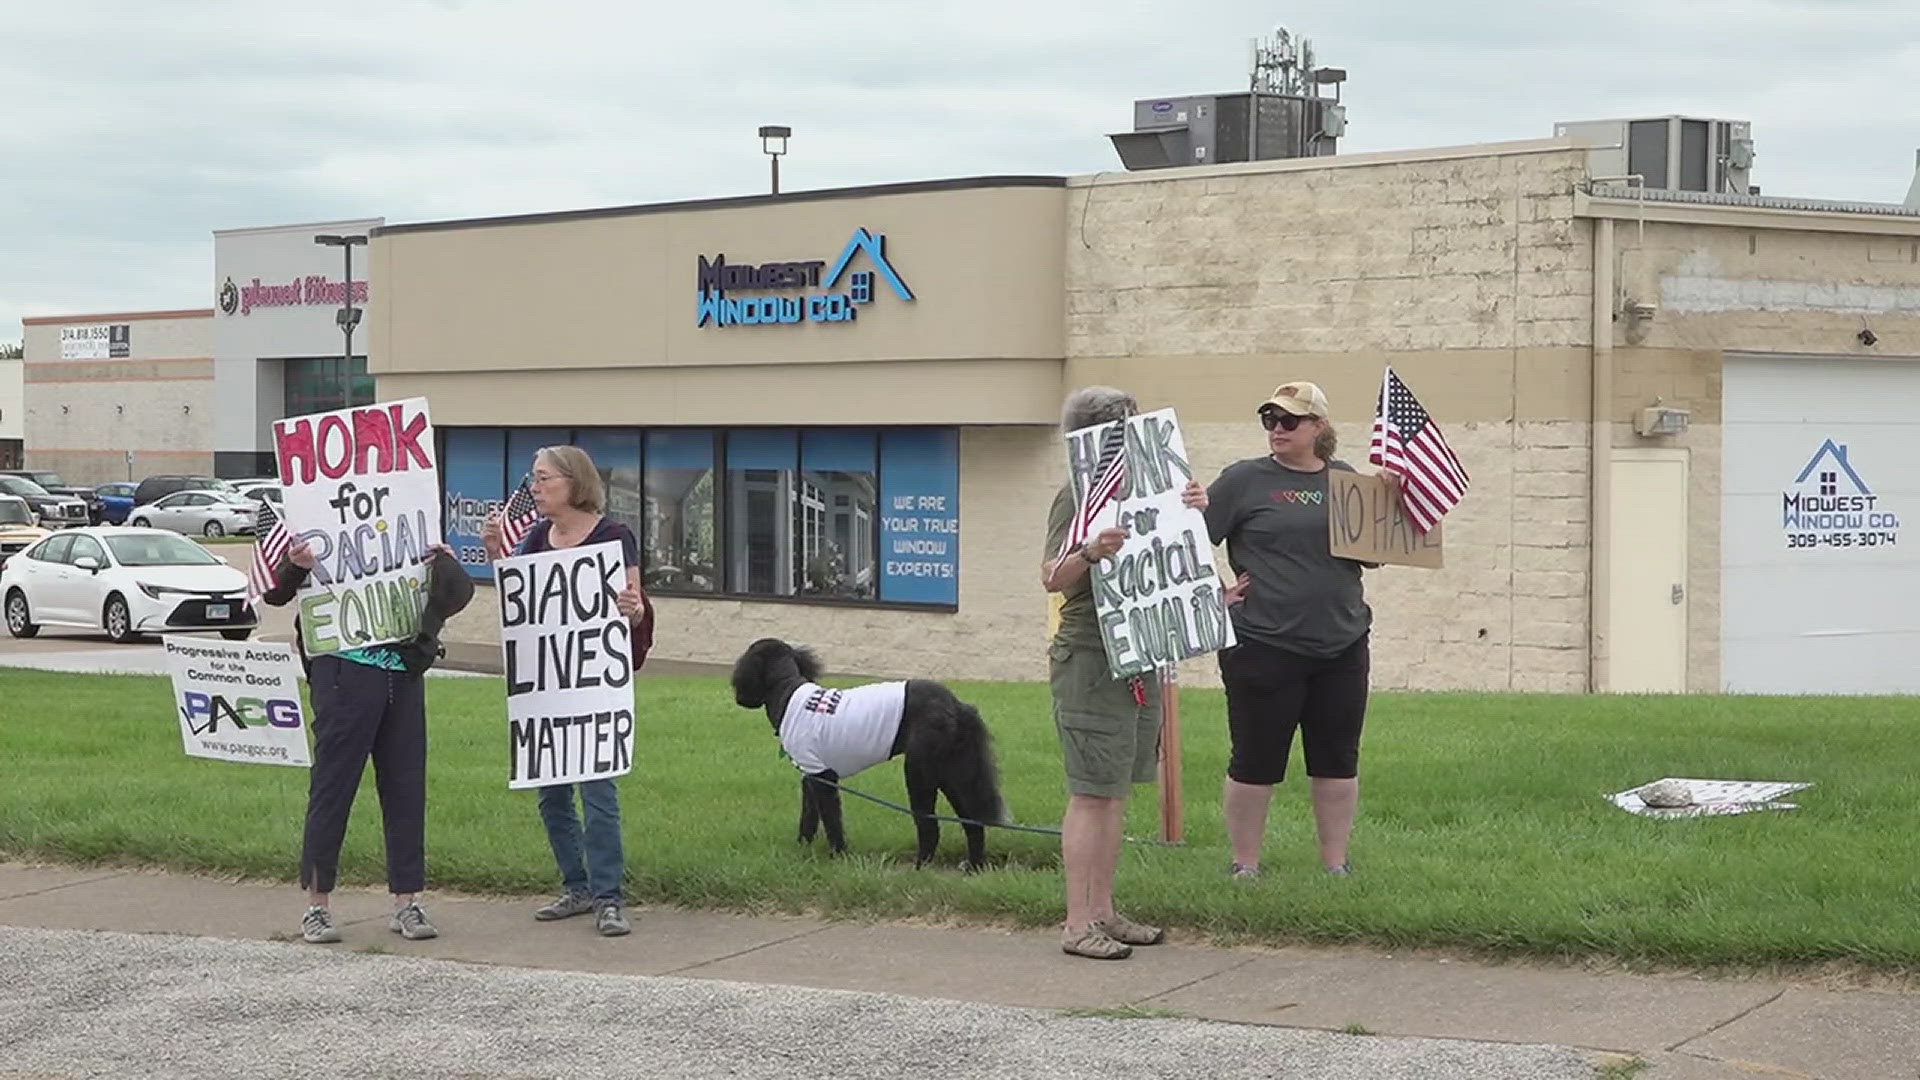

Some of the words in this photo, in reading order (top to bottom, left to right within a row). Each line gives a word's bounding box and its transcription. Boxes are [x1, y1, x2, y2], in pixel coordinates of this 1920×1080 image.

[698, 254, 825, 290] MIDWEST
[241, 277, 302, 316] planet
[698, 290, 805, 328] WINDOW
[329, 482, 390, 524] for
[893, 496, 914, 510] WE
[918, 496, 946, 511] ARE
[1782, 490, 1878, 513] MIDWEST
[882, 517, 918, 532] YOUR
[923, 518, 960, 533] TRUE
[1332, 479, 1365, 547] NO
[1372, 486, 1440, 554] HA
[1782, 512, 1863, 530] WINDOW
[1869, 513, 1900, 528] CO.
[893, 540, 946, 555] WINDOW
[1787, 532, 1896, 548] 309-455-3074
[886, 561, 954, 578] EXPERTS!
[166, 643, 240, 661] Progressive
[244, 649, 290, 663] Action
[506, 620, 629, 697] LIVES
[187, 668, 242, 684] Common
[246, 673, 281, 687] Good
[210, 662, 225, 671] for
[228, 663, 246, 673] the
[183, 691, 300, 734] PACG
[510, 709, 632, 781] MATTER
